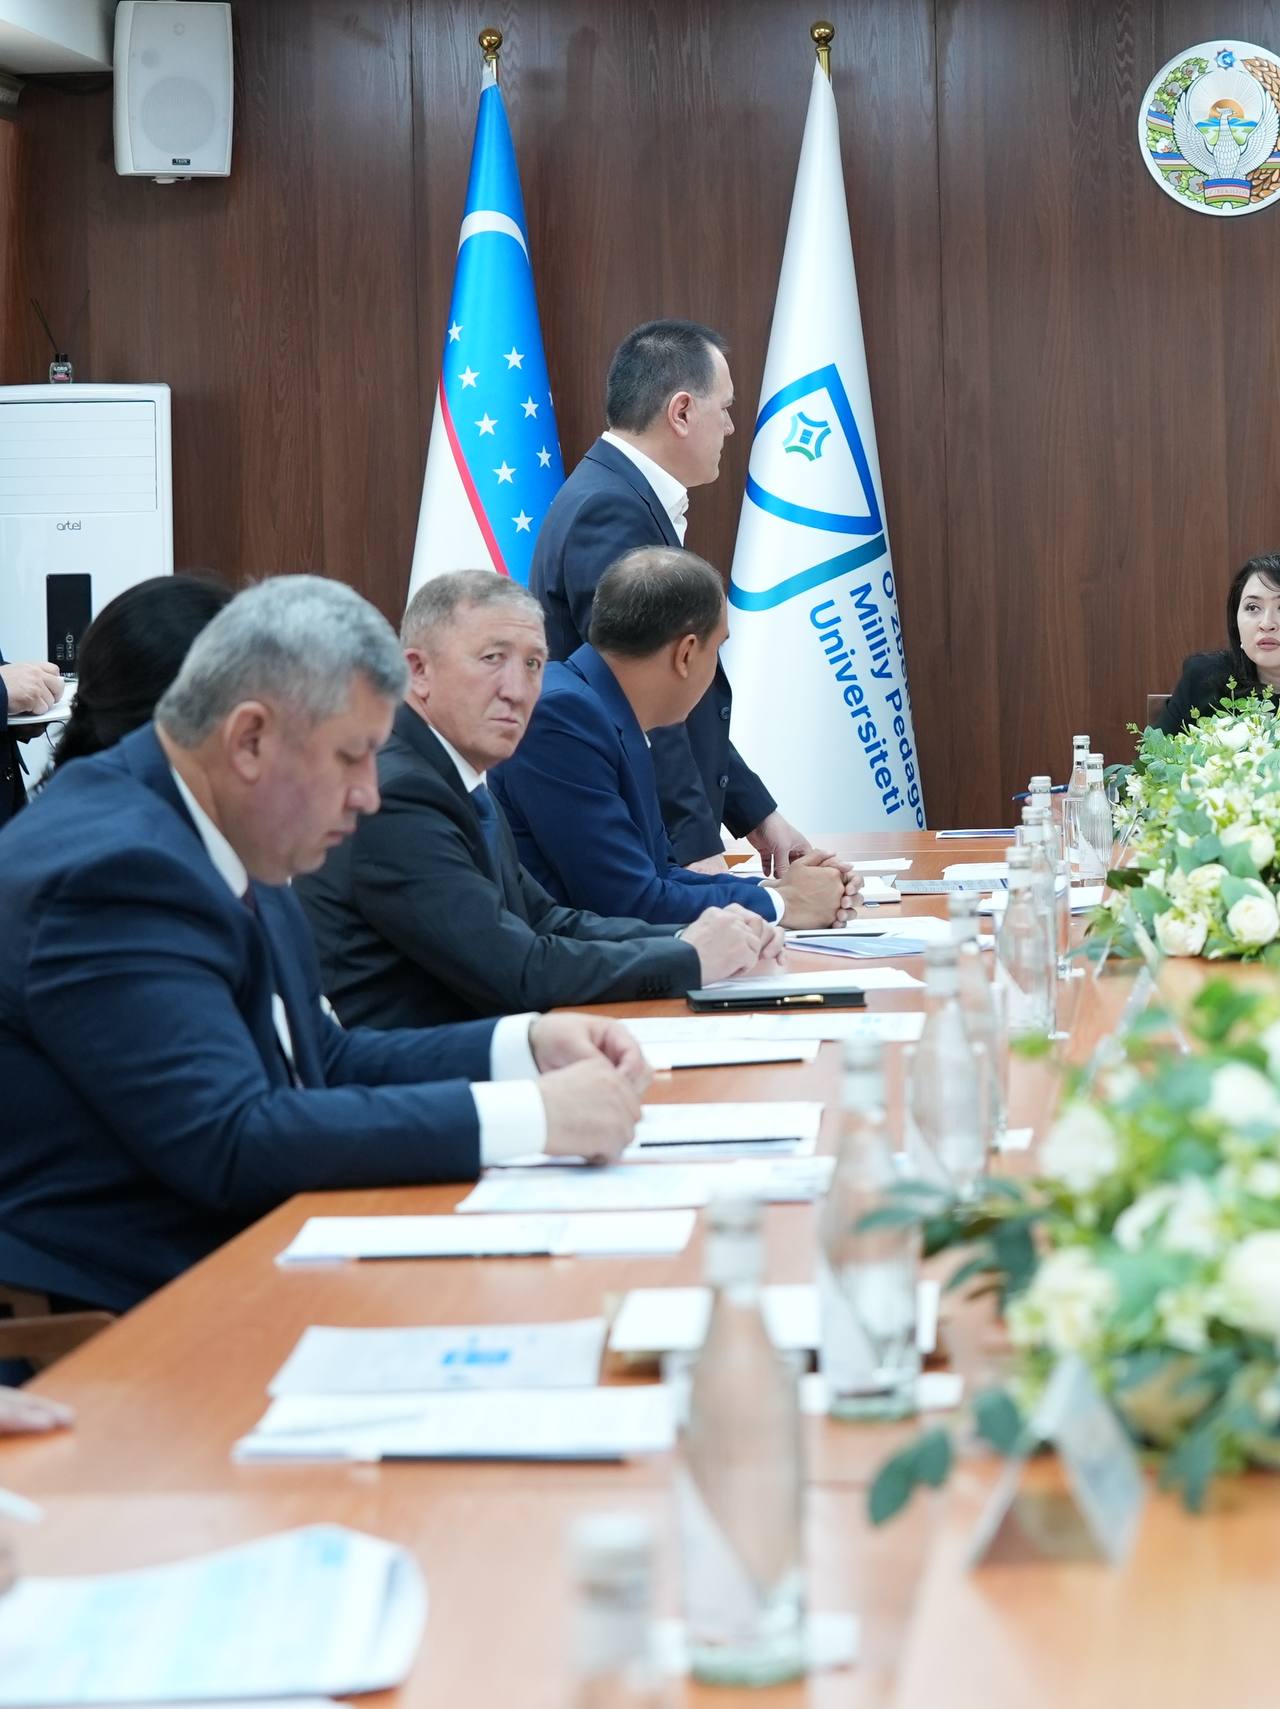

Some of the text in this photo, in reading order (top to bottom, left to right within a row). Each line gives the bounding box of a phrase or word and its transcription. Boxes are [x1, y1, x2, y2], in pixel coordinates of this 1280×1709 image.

[56, 519, 82, 531] artel
[809, 599, 905, 815] Universiteti
[850, 582, 924, 830] Milliy Pedago
